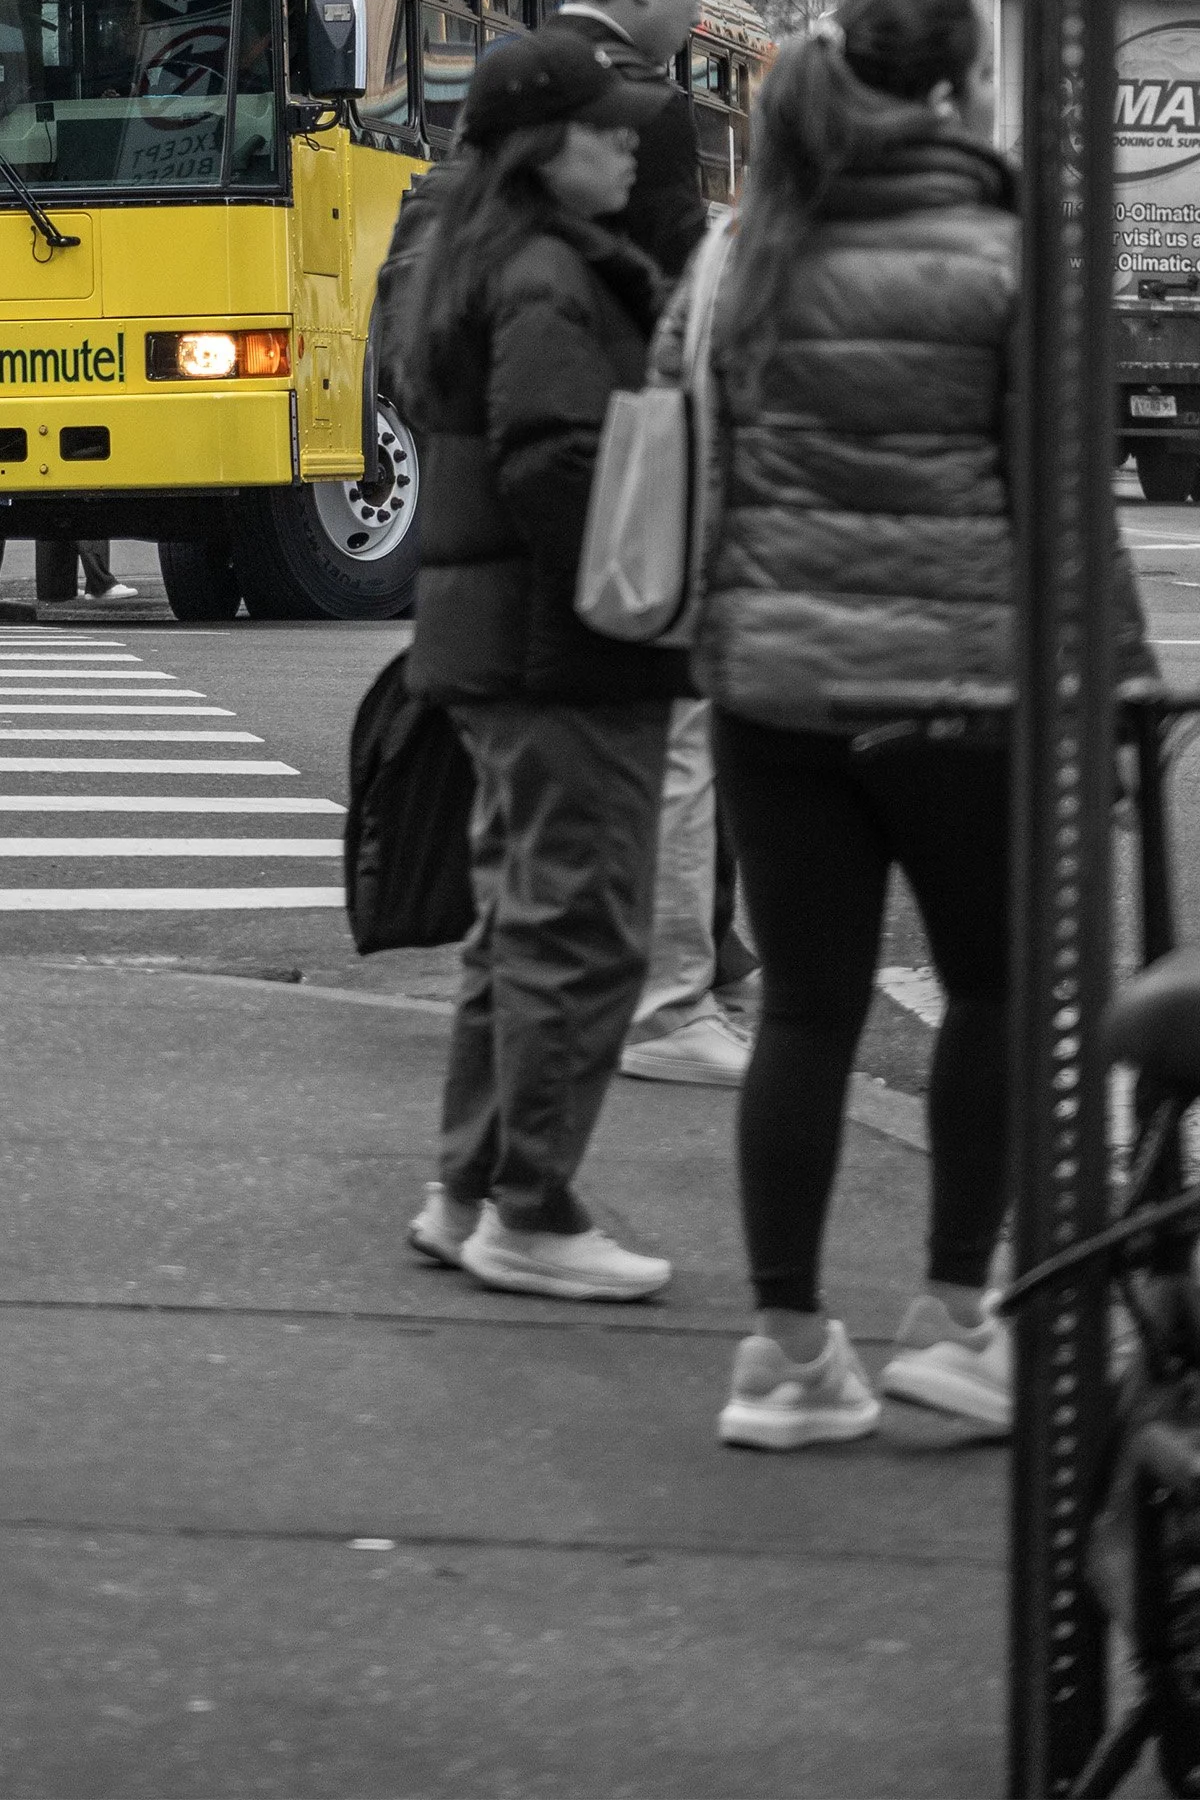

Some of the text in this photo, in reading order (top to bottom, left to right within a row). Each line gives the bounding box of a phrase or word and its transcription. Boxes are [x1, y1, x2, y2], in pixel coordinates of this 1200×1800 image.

[1113, 84, 1200, 126] MA
[1157, 137, 1174, 148] OIL
[1176, 137, 1200, 149] SUP
[1123, 228, 1161, 246] visit
[1166, 233, 1188, 247] us
